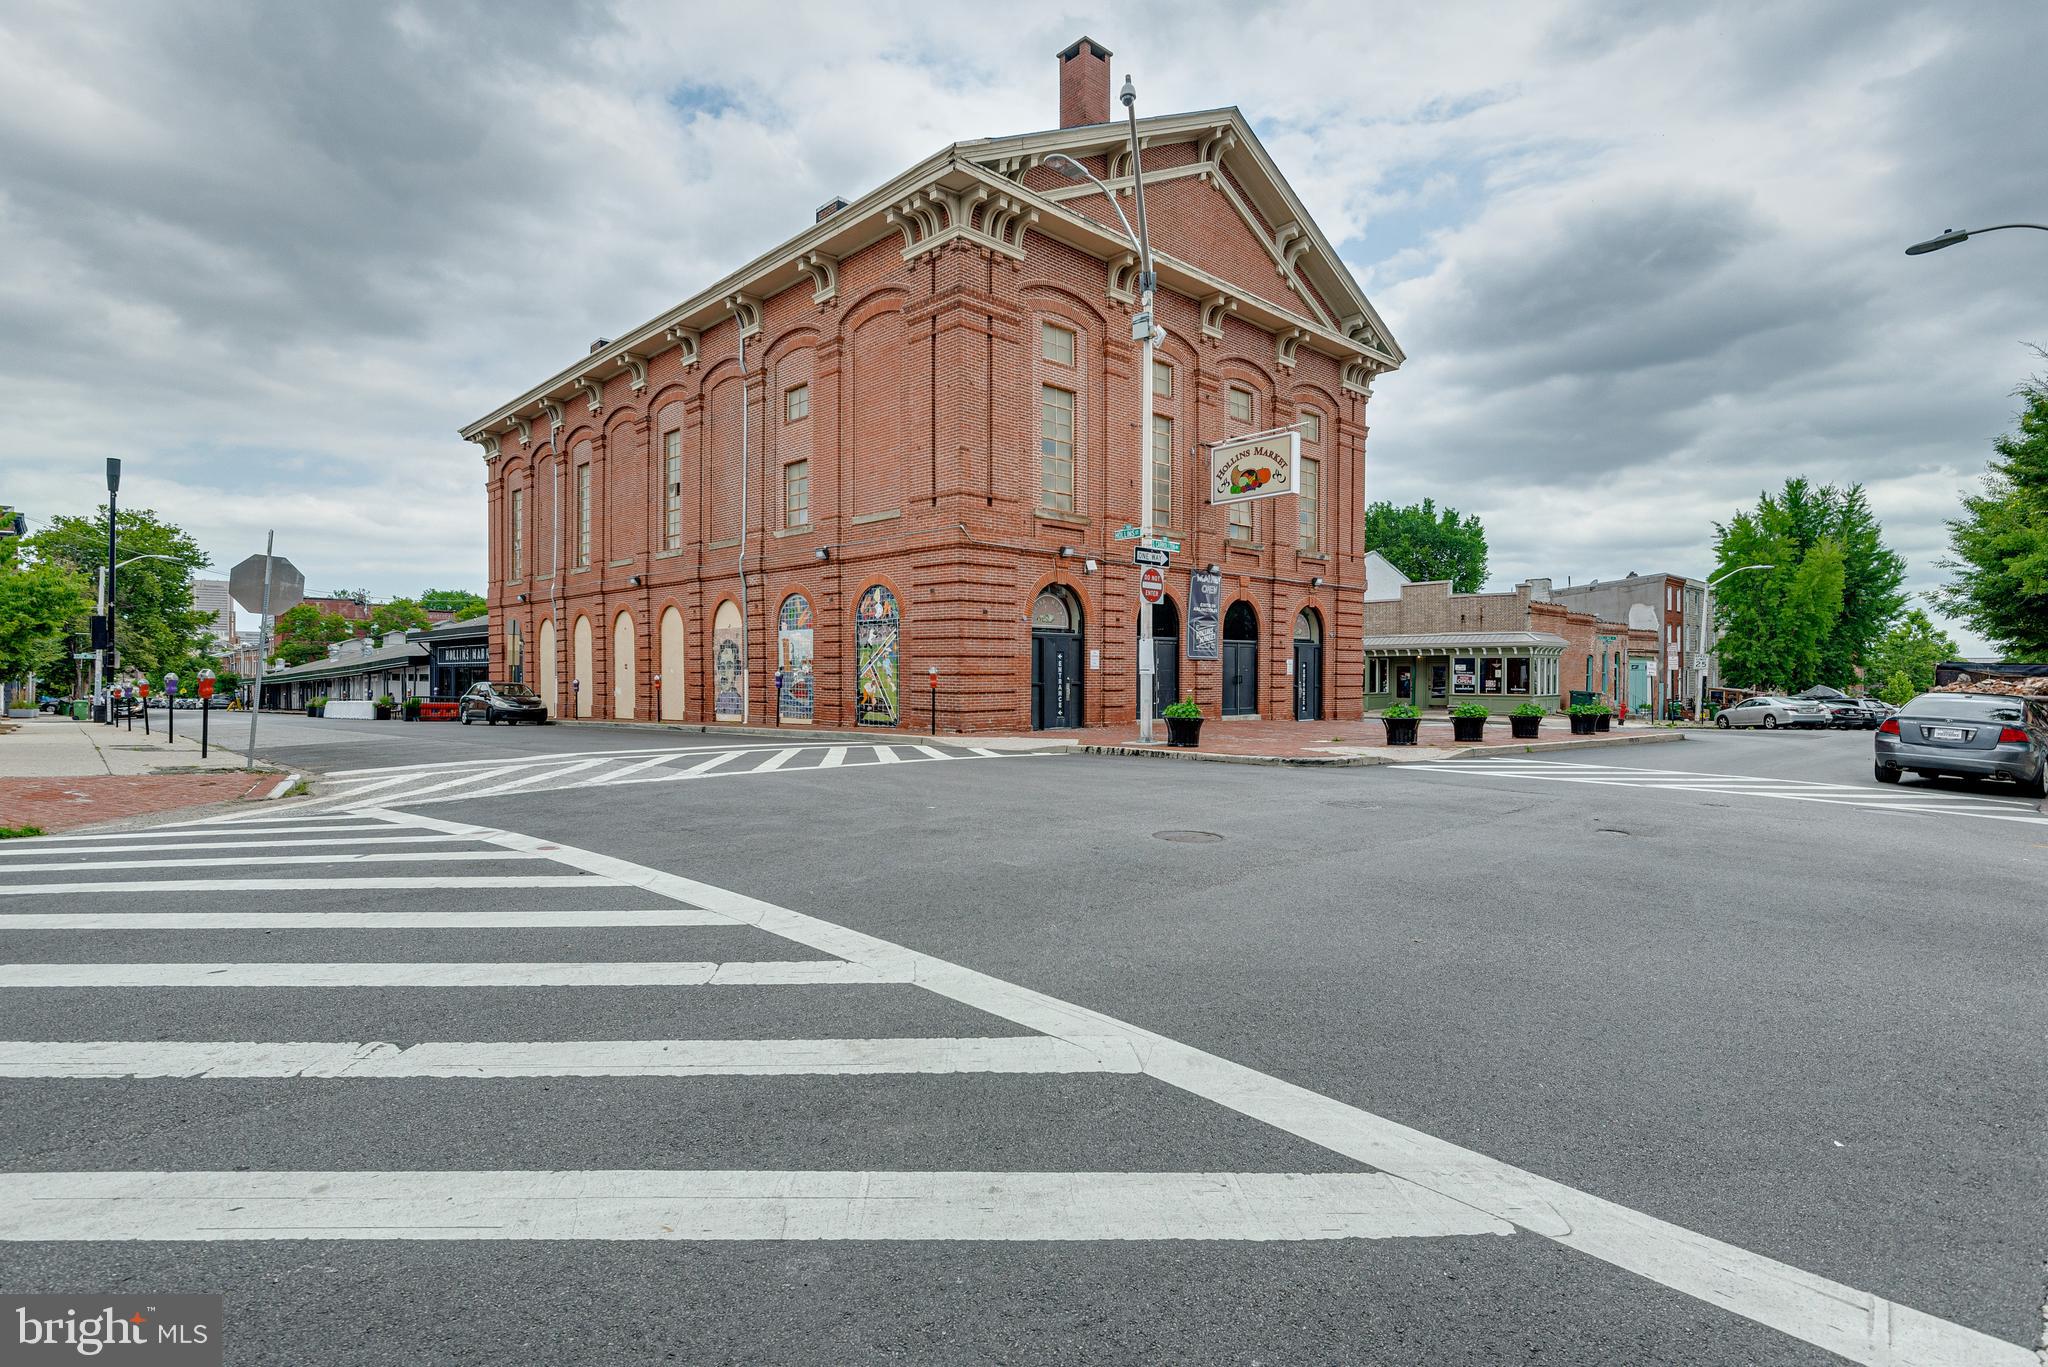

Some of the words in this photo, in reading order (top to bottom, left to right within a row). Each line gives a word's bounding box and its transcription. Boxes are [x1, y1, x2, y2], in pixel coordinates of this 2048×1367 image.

[1216, 449, 1251, 480] HOLLINS
[1253, 447, 1288, 469] MARKET
[1138, 551, 1149, 560] ONE
[1151, 553, 1162, 561] WAY
[446, 649, 469, 660] HOLLINS
[1695, 660, 1707, 668] 25
